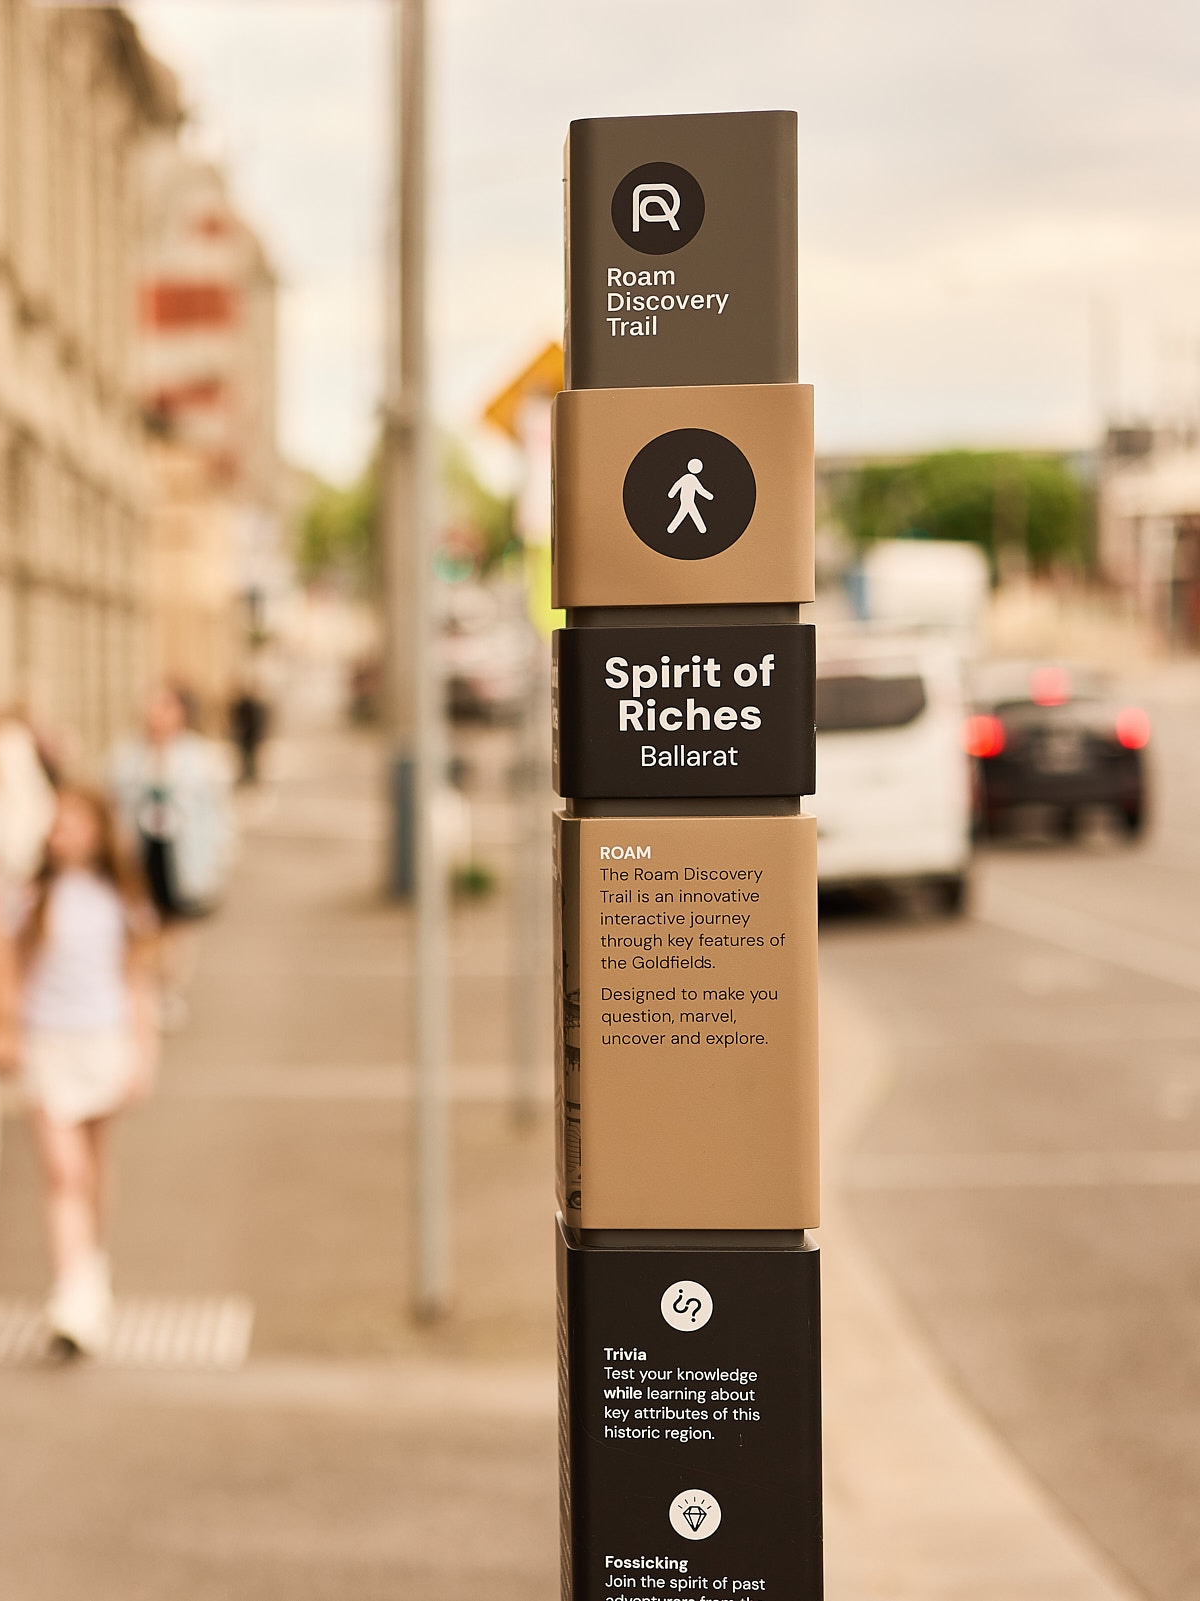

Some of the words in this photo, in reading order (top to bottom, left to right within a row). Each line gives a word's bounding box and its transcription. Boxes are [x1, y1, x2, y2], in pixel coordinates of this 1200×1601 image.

[607, 268, 676, 286] Roam
[607, 292, 729, 314] Discovery
[606, 316, 658, 336] Trail
[605, 655, 720, 698] Spirit
[734, 654, 775, 687] of
[620, 698, 762, 731] Riches
[641, 745, 738, 767] Ballarat
[600, 846, 651, 860] ROAM
[600, 868, 629, 881] The
[634, 868, 679, 881] Roam
[684, 867, 763, 884] Discovery
[600, 890, 632, 904] Trail
[637, 890, 650, 903] is
[654, 892, 674, 903] an
[679, 889, 760, 902] innovative
[600, 912, 685, 926] interactive
[690, 912, 750, 928] journey
[600, 934, 662, 950] through
[668, 934, 693, 950] key
[699, 934, 764, 947] features
[770, 932, 786, 946] of
[601, 956, 626, 970] the
[632, 956, 716, 970] Goldfields.
[601, 987, 676, 1004] Designed
[681, 988, 698, 1000] to
[703, 987, 745, 1000] make
[750, 990, 778, 1004] you
[602, 1010, 675, 1026] question,
[680, 1009, 737, 1024] marvel,
[602, 1034, 665, 1045] uncover
[670, 1032, 700, 1045] and
[706, 1032, 768, 1048] explore.
[604, 1348, 647, 1361] Trivia
[604, 1367, 635, 1380] Test
[639, 1369, 673, 1383] your
[677, 1368, 758, 1385] knowledge
[604, 1386, 643, 1400] while
[647, 1387, 706, 1404] learning
[711, 1388, 755, 1402] about
[604, 1406, 630, 1422] key
[634, 1407, 709, 1420] attributes
[713, 1407, 728, 1420] of
[733, 1408, 761, 1422] this
[604, 1426, 661, 1440] historic
[665, 1427, 715, 1442] region.
[605, 1556, 688, 1573] Fossicking
[605, 1575, 636, 1589] Join
[640, 1575, 666, 1589] the
[670, 1576, 709, 1592] spirit
[713, 1577, 728, 1590] of
[733, 1578, 766, 1593] past
